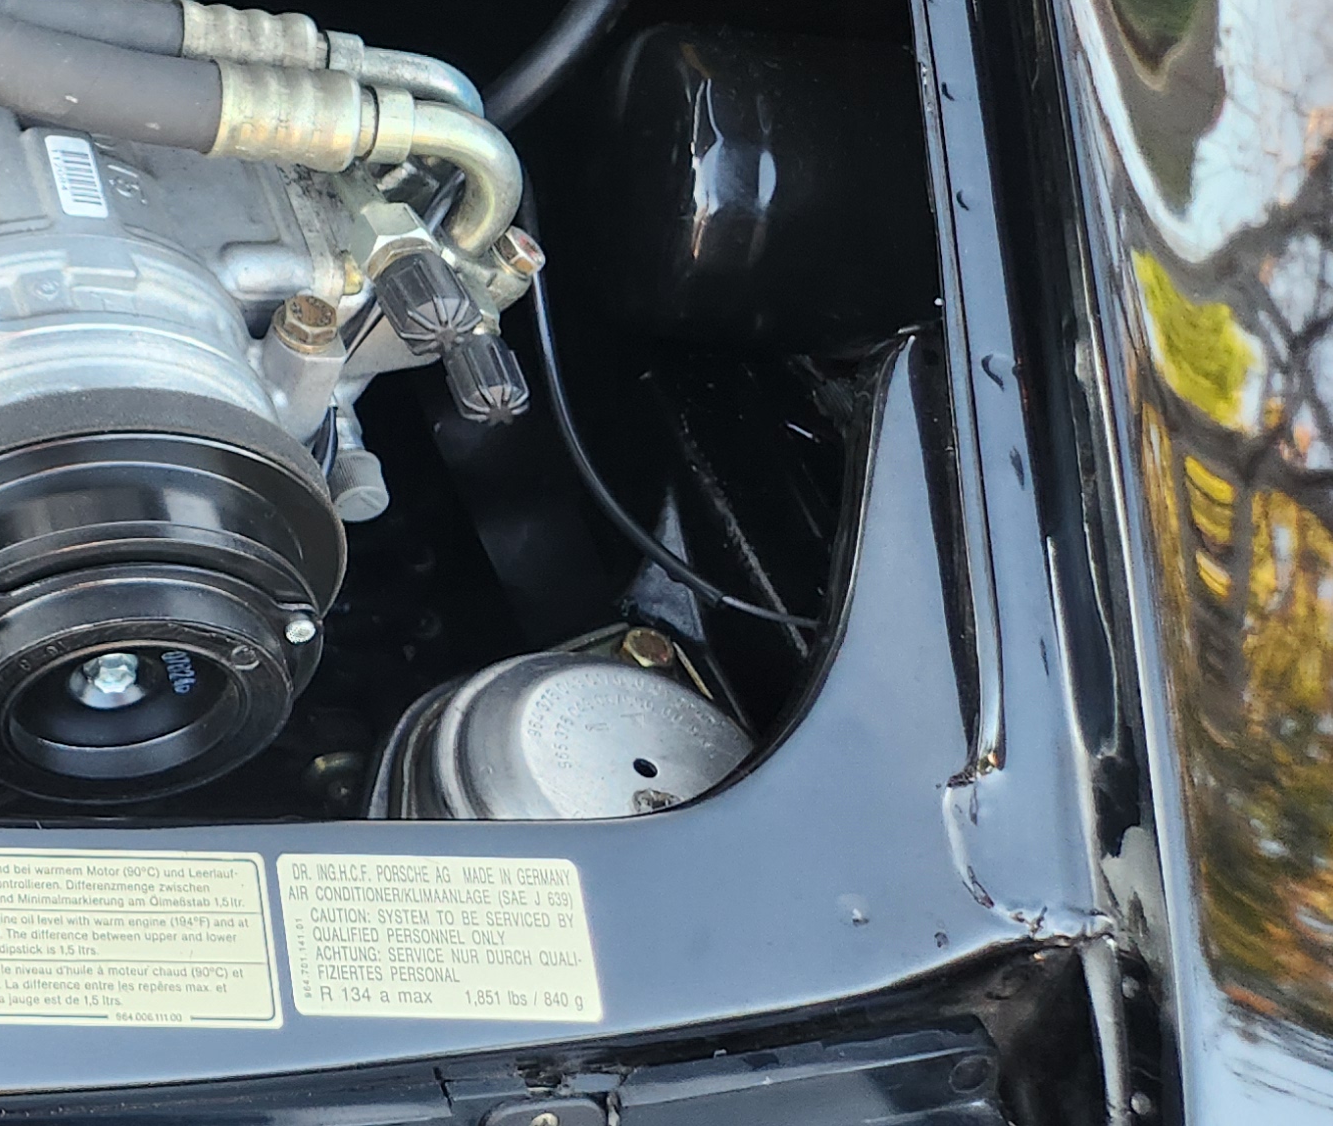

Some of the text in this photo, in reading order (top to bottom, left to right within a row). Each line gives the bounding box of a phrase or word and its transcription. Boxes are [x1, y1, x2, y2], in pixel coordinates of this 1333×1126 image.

[14, 864, 31, 875] bei
[34, 866, 83, 875] warmem
[86, 866, 119, 876] Motor
[123, 866, 160, 878] (90°C)
[163, 867, 184, 878] und
[188, 868, 239, 879] Leerlauf-
[292, 862, 570, 886] DR. ING.H.C.F. PORSCHE AG MADE IN GERMANY
[66, 879, 154, 893] Differenzmenge
[159, 882, 210, 893] zwischen
[18, 894, 124, 908] Minimalmarkierung
[128, 898, 145, 907] am
[149, 894, 211, 908] Ölmeßstab
[288, 885, 573, 909] AIR CONDITIONER/KLIMAANLAGE (SAE J 639)
[21, 915, 34, 925] oil
[37, 914, 63, 925] level
[67, 916, 90, 926] with
[93, 918, 124, 927] warm
[128, 917, 166, 928] engine
[170, 915, 210, 929] (194°F)
[213, 917, 234, 927] and
[238, 918, 249, 928] at
[310, 907, 574, 928] CAUTION: SYSTEM TO BE SERVICED BY
[6, 929, 27, 940] The
[30, 929, 88, 941] difference
[92, 930, 141, 941] between
[144, 932, 177, 943] upper
[181, 932, 203, 942] and
[206, 932, 237, 942] lower
[312, 926, 505, 945] QUALIFIED PERSONNEL ONLY
[46, 945, 56, 955] is
[60, 945, 75, 956] 1,5
[78, 945, 99, 956] ltrs.
[315, 946, 582, 967] ACHTUNG: SERVICE NUR DURCH QUALI-
[1, 963, 12, 974] le
[15, 964, 53, 975] niveau
[56, 965, 93, 975] d'huile
[97, 965, 105, 976] à
[108, 967, 148, 976] moteur
[152, 966, 188, 977] chaud
[191, 966, 229, 979] (90°C)
[232, 968, 244, 978] et
[317, 964, 460, 983] FIZIERTES PERSONAL
[5, 979, 20, 990] La
[22, 979, 81, 991] difference
[84, 981, 115, 991] entre
[118, 980, 135, 992] les
[186, 983, 211, 992] max.
[215, 983, 227, 993] et
[8, 994, 40, 1006] jauge
[44, 995, 61, 1005] est
[65, 995, 79, 1005] de
[83, 995, 99, 1007] 1,5
[102, 995, 123, 1007] ltrs.
[320, 985, 584, 1011] R 134 a max 1,851 lbs / 840 g
